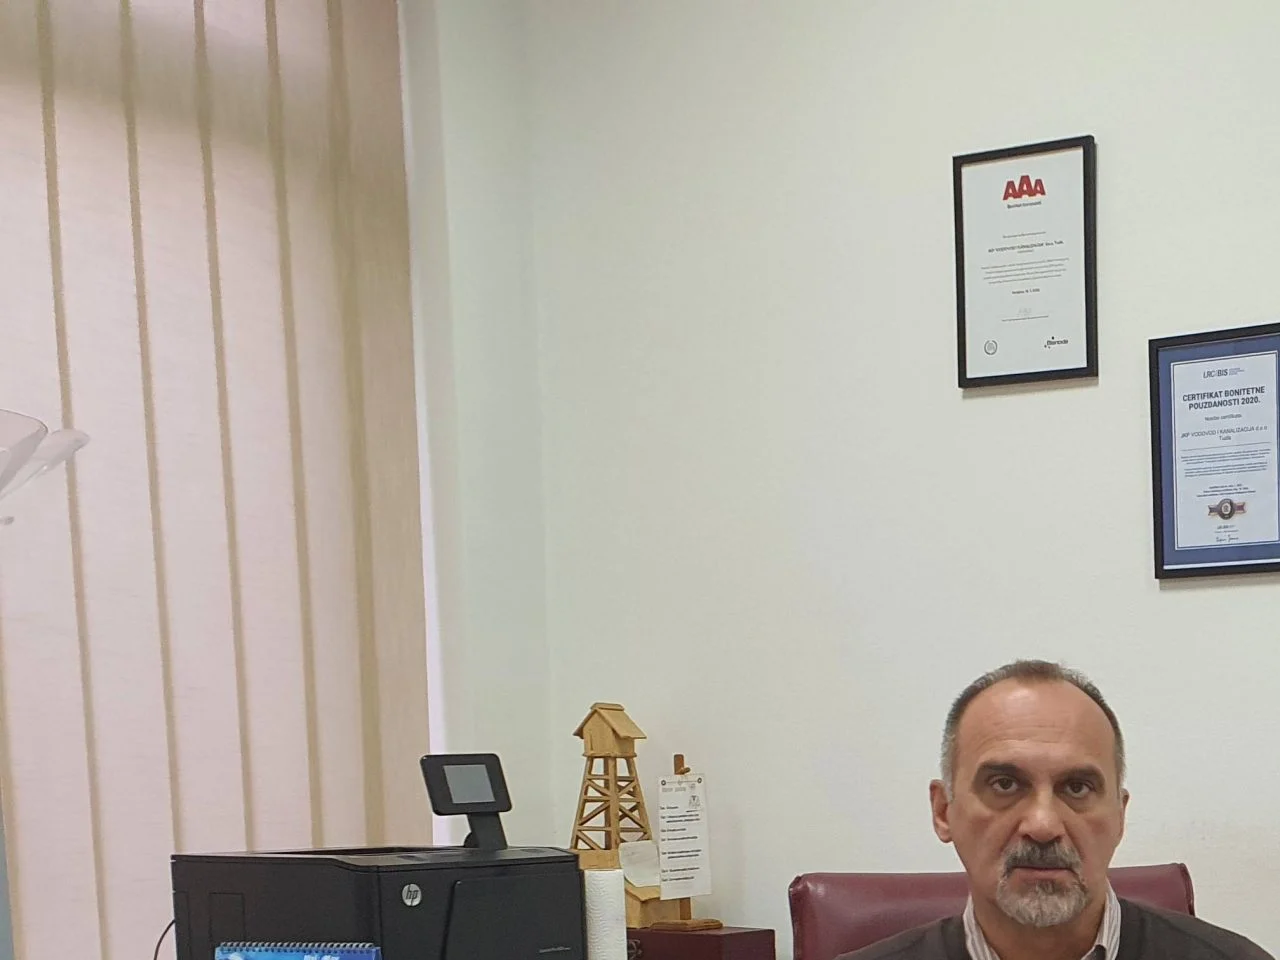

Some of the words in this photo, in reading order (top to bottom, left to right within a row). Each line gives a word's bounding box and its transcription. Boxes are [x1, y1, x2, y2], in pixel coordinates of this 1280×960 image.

[1002, 174, 1046, 201] AAA
[1182, 391, 1223, 402] CERTIFIKAT
[1224, 385, 1265, 398] BONITETNE
[1188, 398, 1240, 411] POUZDANOSTI
[1241, 396, 1261, 405] 2020.
